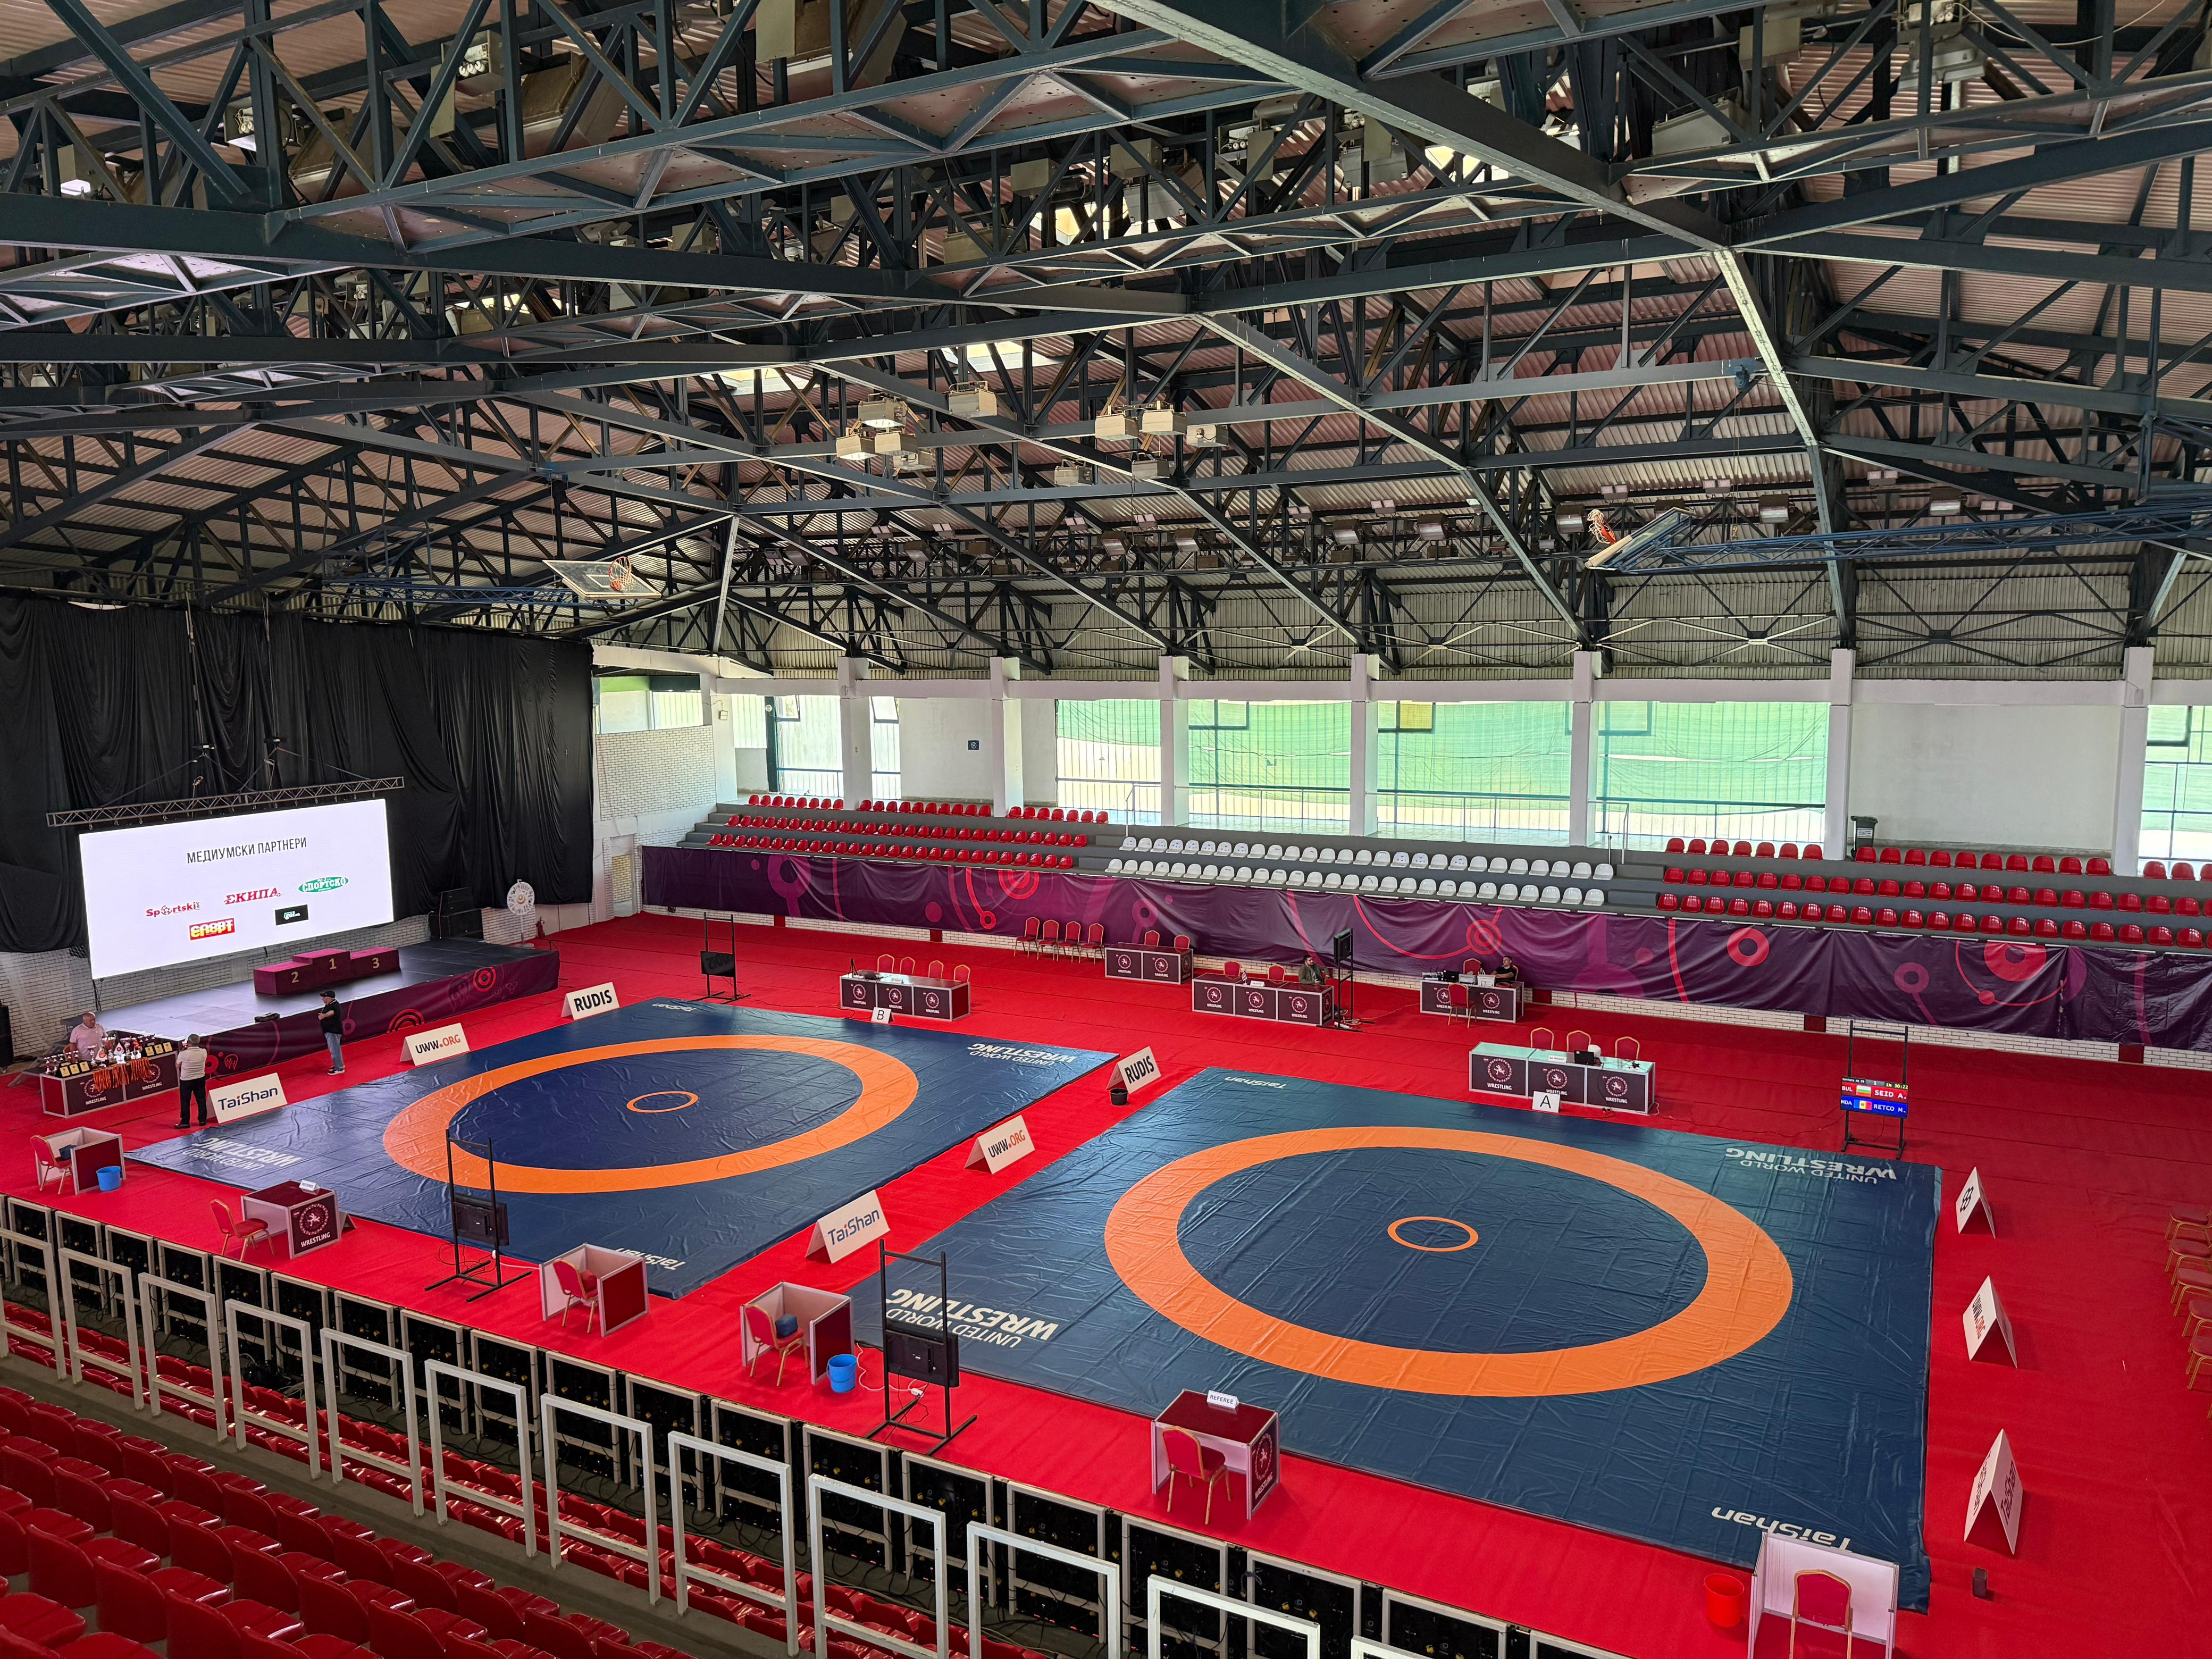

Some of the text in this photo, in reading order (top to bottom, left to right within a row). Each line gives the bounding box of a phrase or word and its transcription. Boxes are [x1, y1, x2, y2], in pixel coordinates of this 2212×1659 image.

[187, 837, 307, 864] МЕДИУМСКИ ПАРТНЕРИ
[224, 887, 279, 904] ЕКИПА
[329, 958, 337, 969] 1
[372, 957, 380, 969] 3
[291, 971, 299, 983] 2
[574, 989, 613, 1012] RUDIS
[877, 1010, 884, 1020] B
[415, 1034, 461, 1054] UWW.ORG
[967, 1043, 1077, 1063] WRESTLING
[970, 1051, 1055, 1066] UNITED WORLD
[1124, 1055, 1154, 1084] RUDIS
[1487, 1082, 1512, 1091] WRESTLING
[218, 1087, 278, 1110] TaiShan
[1540, 1095, 1552, 1109] A
[988, 1129, 1026, 1158] UWW.ORG
[1725, 1147, 1897, 1180] WRESTLING
[1740, 1160, 1877, 1185] UNITED WORLD
[827, 1209, 880, 1245] TaiShan
[300, 1232, 331, 1247] WRESTLING
[885, 1289, 1059, 1340] WRESTLING
[952, 1324, 1021, 1348] UNITED
[1210, 1394, 1234, 1404] REFEREE
[1254, 1472, 1273, 1499] WRESTLING
